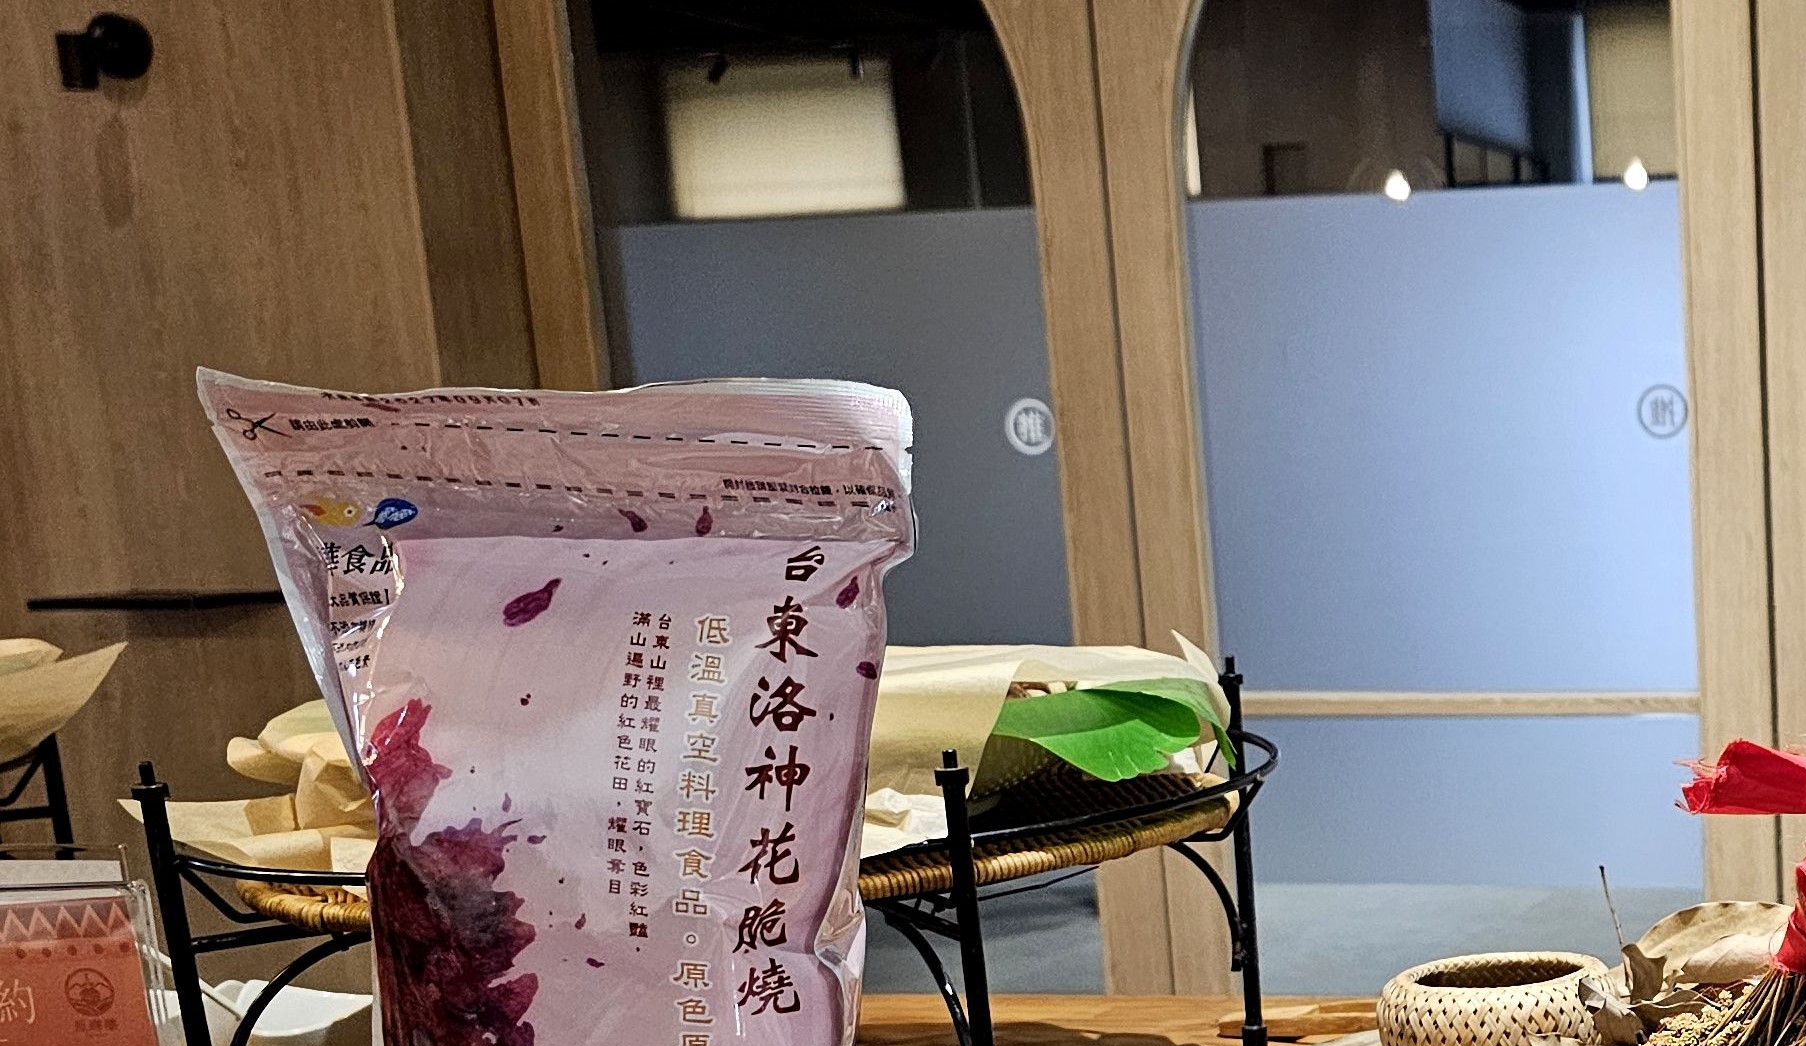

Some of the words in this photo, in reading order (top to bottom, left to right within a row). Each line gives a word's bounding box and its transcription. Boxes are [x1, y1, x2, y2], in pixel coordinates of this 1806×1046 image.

[732, 545, 825, 1016] 台東洛神花脆燒
